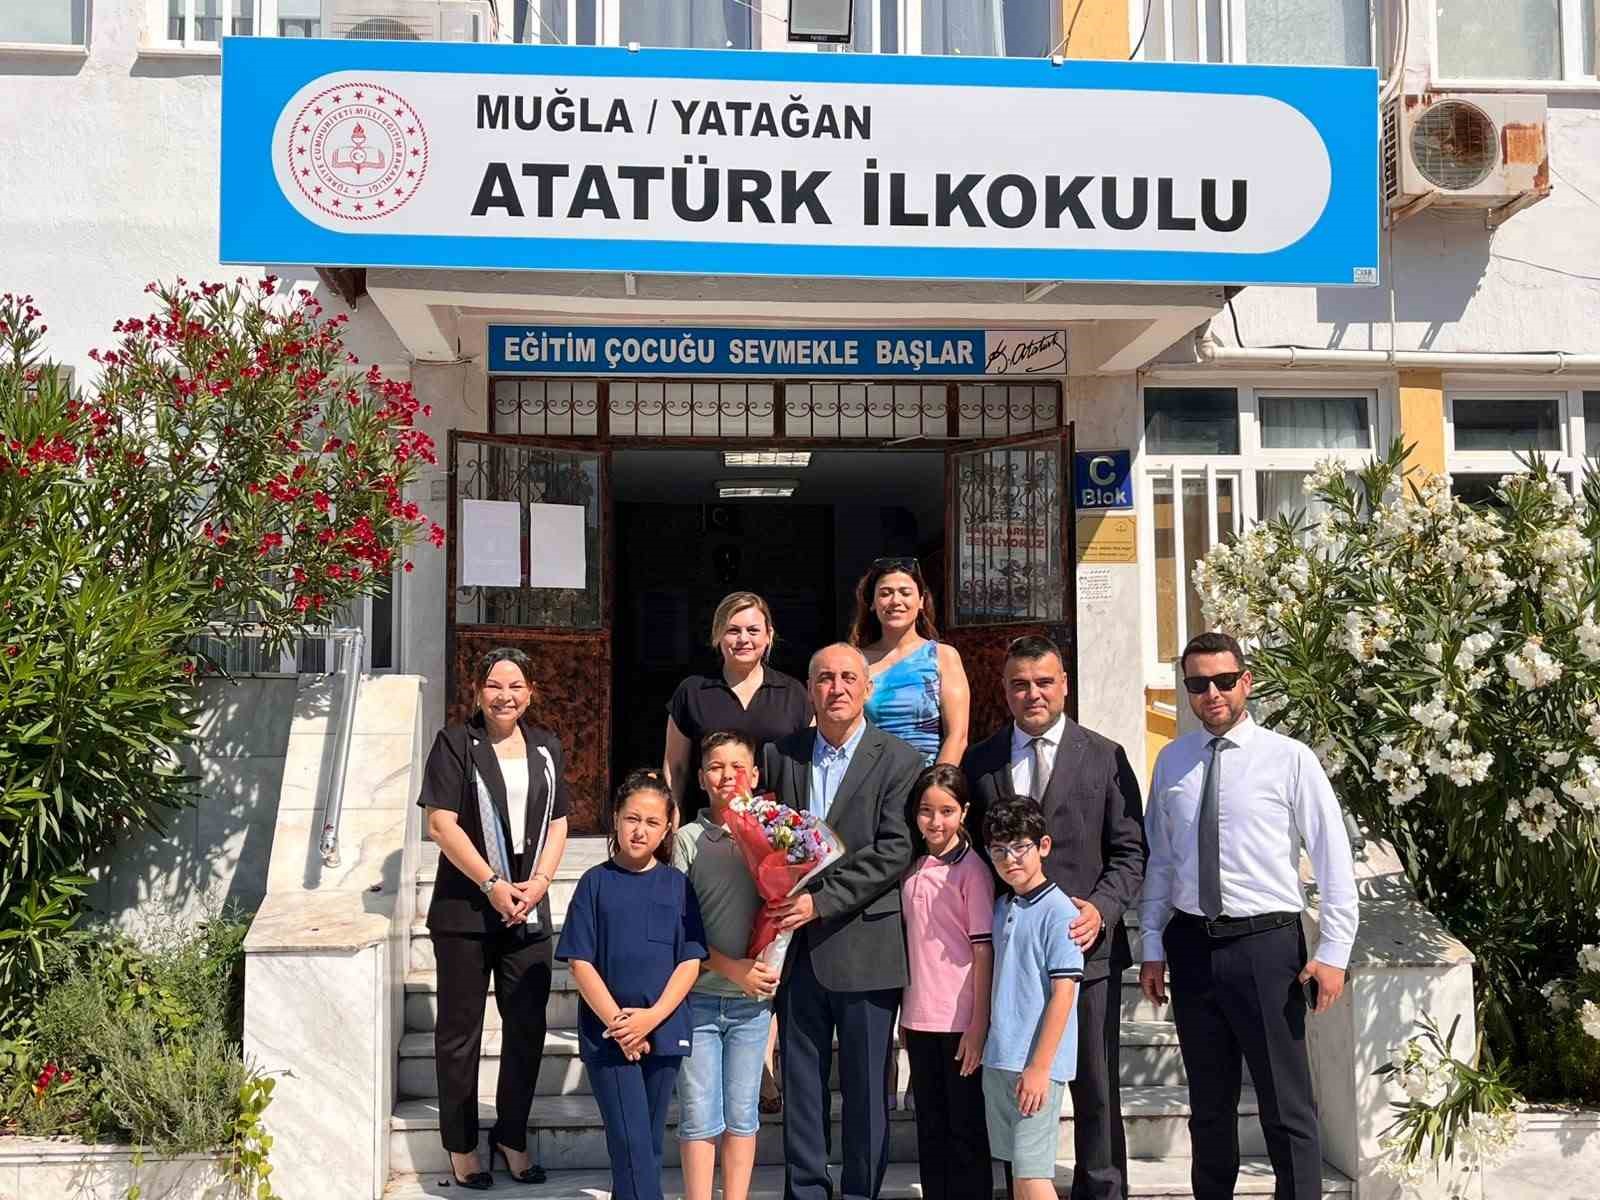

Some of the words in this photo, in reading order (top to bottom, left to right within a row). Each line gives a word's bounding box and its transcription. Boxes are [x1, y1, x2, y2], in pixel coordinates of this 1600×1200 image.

[476, 88, 634, 133] MUĞLA
[647, 99, 658, 134] /
[672, 94, 871, 139] YATAĞAN
[316, 163, 349, 193] TÜRKİYE
[470, 154, 833, 224] ATATÜRK
[863, 158, 1248, 233] İLKOKULU
[504, 331, 596, 362] EĞİTİM
[604, 333, 716, 369] ÇOCUĞU
[729, 339, 859, 364] SEVMEKLE
[876, 340, 974, 371] BAŞLAR
[1090, 455, 1116, 486] C
[1082, 487, 1128, 505] Blok
